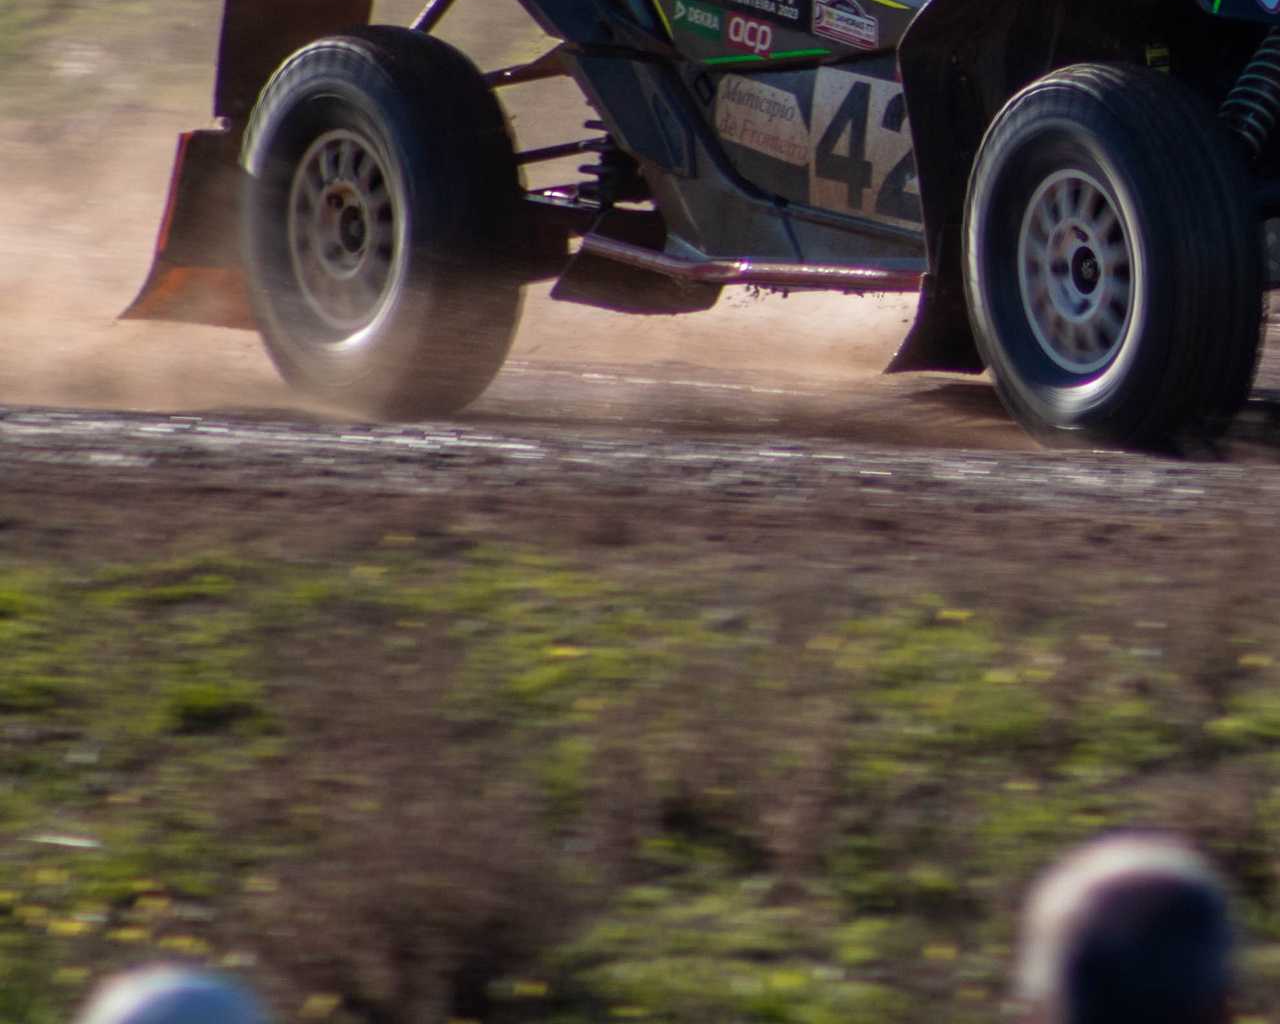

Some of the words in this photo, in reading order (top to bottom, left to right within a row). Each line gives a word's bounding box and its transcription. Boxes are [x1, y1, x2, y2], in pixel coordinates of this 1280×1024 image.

[687, 6, 721, 32] DEKRA
[777, 4, 800, 20] 2023
[728, 17, 773, 53] acp
[722, 78, 796, 123] Município
[719, 117, 737, 138] de
[738, 119, 809, 163] Fronteira
[815, 80, 922, 223] 42
